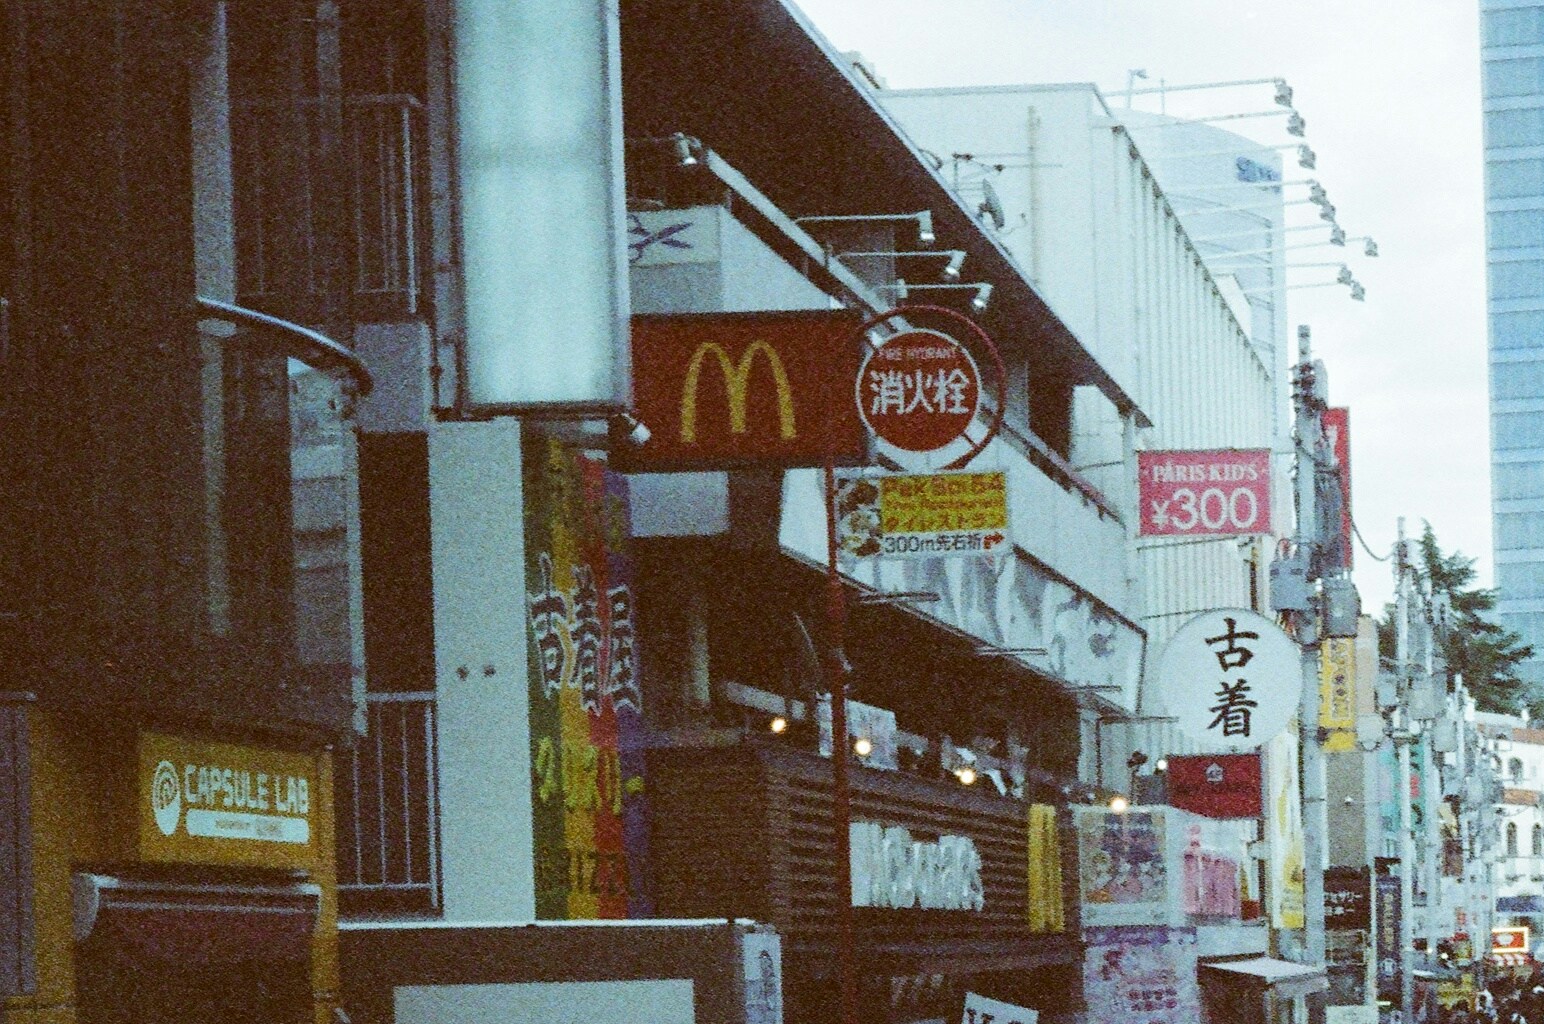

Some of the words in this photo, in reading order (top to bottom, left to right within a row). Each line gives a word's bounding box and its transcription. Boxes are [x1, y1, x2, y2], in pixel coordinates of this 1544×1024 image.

[869, 368, 970, 415] 消火栓
[1152, 460, 1205, 482] PARIS
[1152, 487, 1258, 530] ¥300
[884, 533, 981, 553] 300m先右折
[1205, 617, 1258, 737] 古着
[185, 763, 269, 810] CAPSULE
[275, 774, 309, 815] LAB
